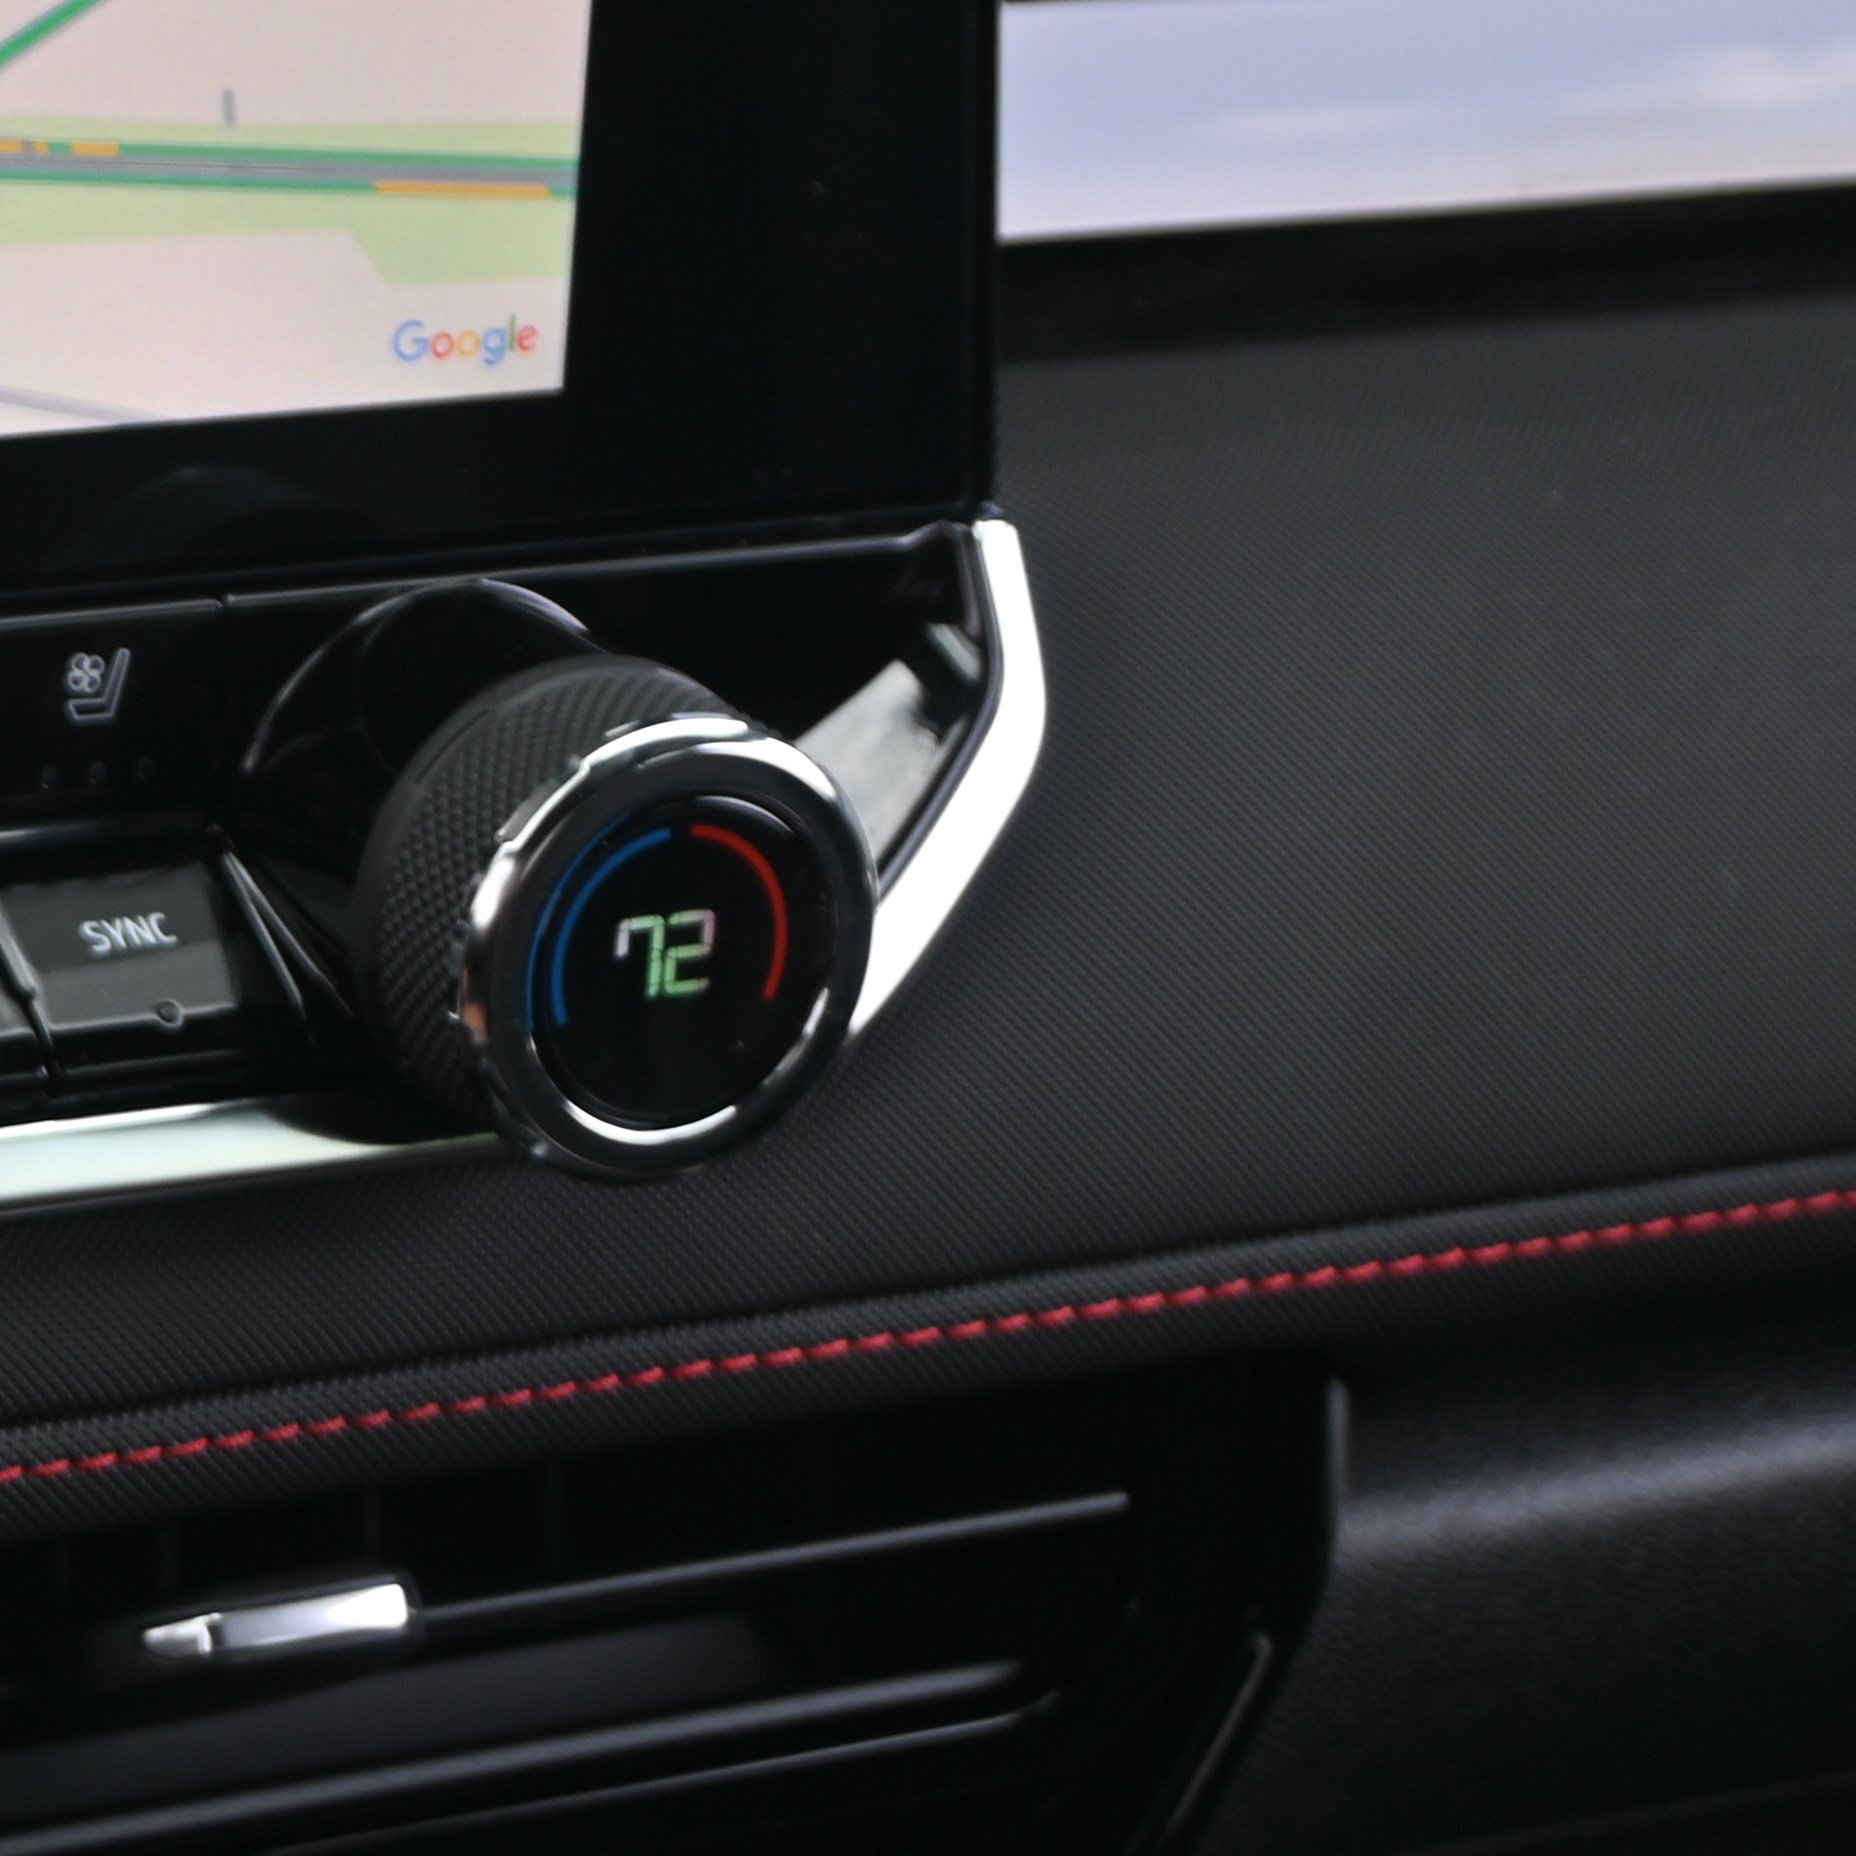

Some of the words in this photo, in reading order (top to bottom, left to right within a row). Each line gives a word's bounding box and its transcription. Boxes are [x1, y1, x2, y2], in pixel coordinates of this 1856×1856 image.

[391, 312, 540, 366] Google
[79, 912, 178, 957] SYNC
[613, 908, 716, 1000] 72
